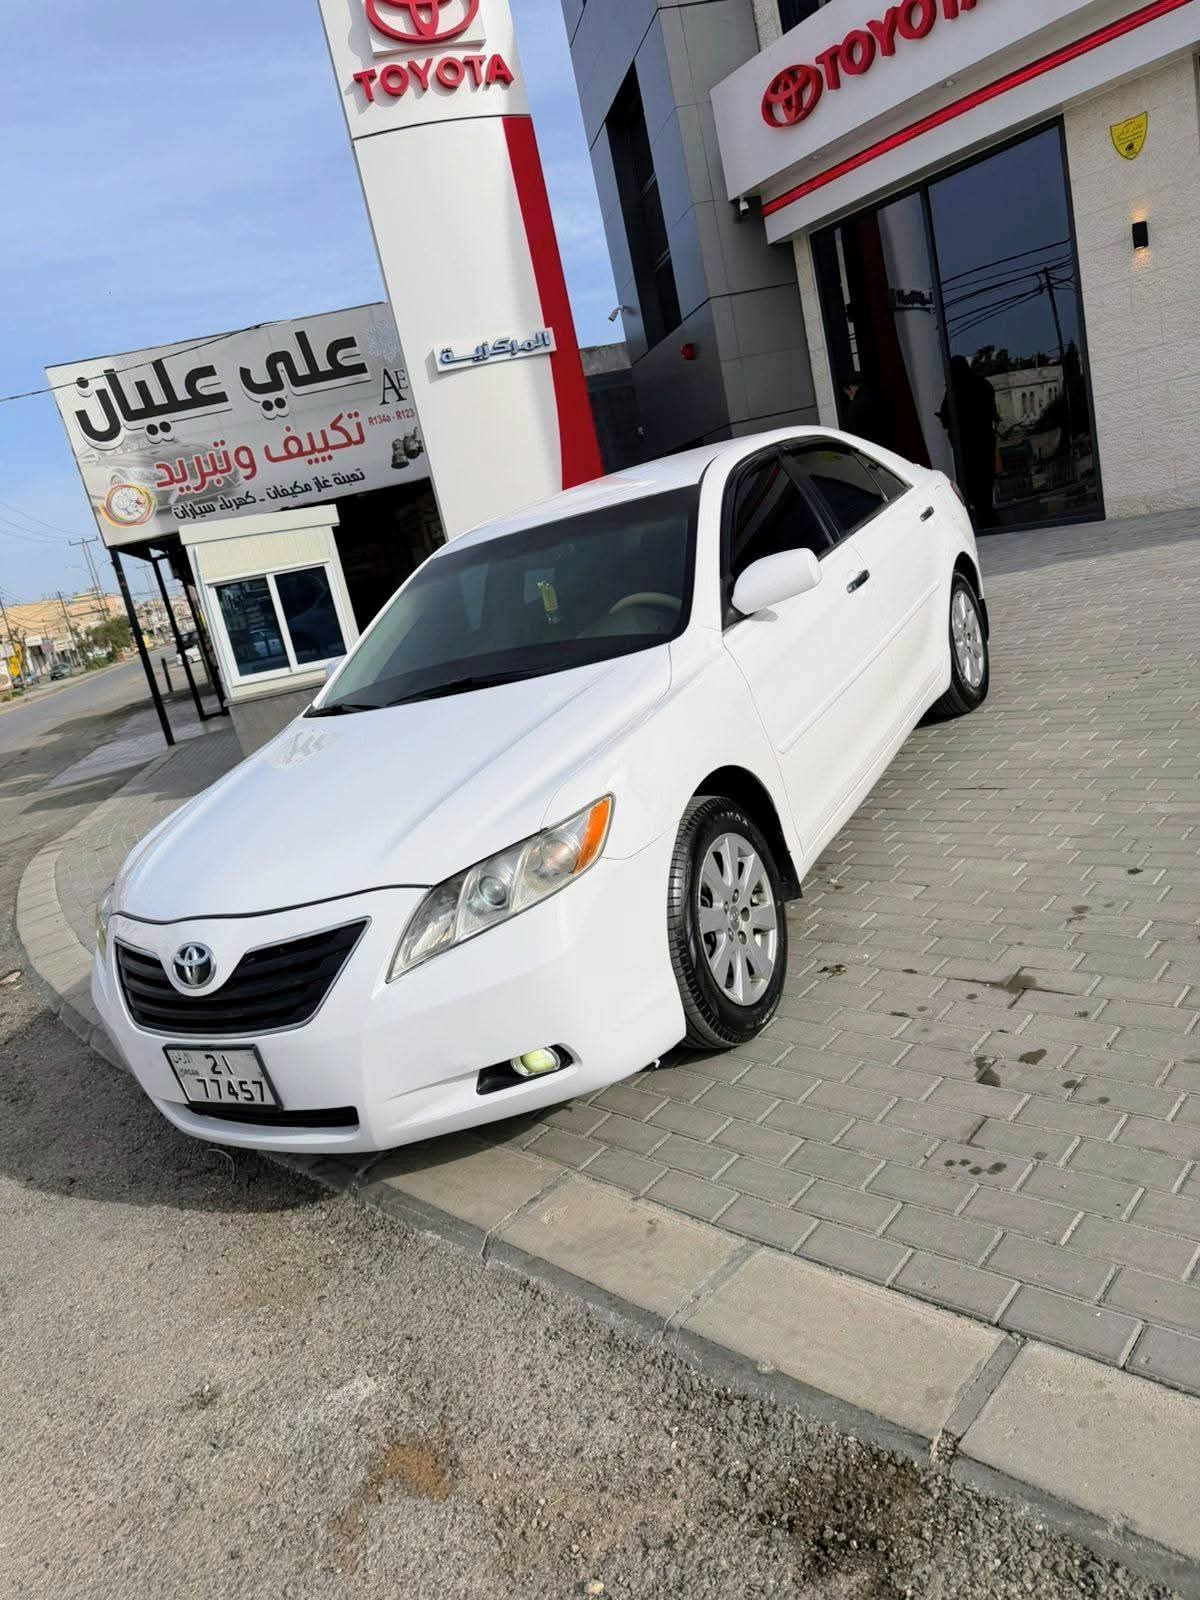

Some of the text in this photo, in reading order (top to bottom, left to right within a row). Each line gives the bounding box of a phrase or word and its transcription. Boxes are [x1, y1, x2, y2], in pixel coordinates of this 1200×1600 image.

[815, 0, 977, 90] TOYO
[353, 53, 514, 103] TOYOTA
[440, 331, 550, 363] المركزية
[75, 331, 369, 442] علي عليان
[155, 411, 365, 493] تكييف وتبريد
[312, 475, 333, 493] غاز
[332, 468, 366, 487] تعبئة
[219, 490, 257, 512] كهرباء
[266, 480, 312, 499] مكيفات
[172, 502, 216, 520] سيارات
[204, 1054, 234, 1075] 21
[196, 1078, 265, 1102] 77457
